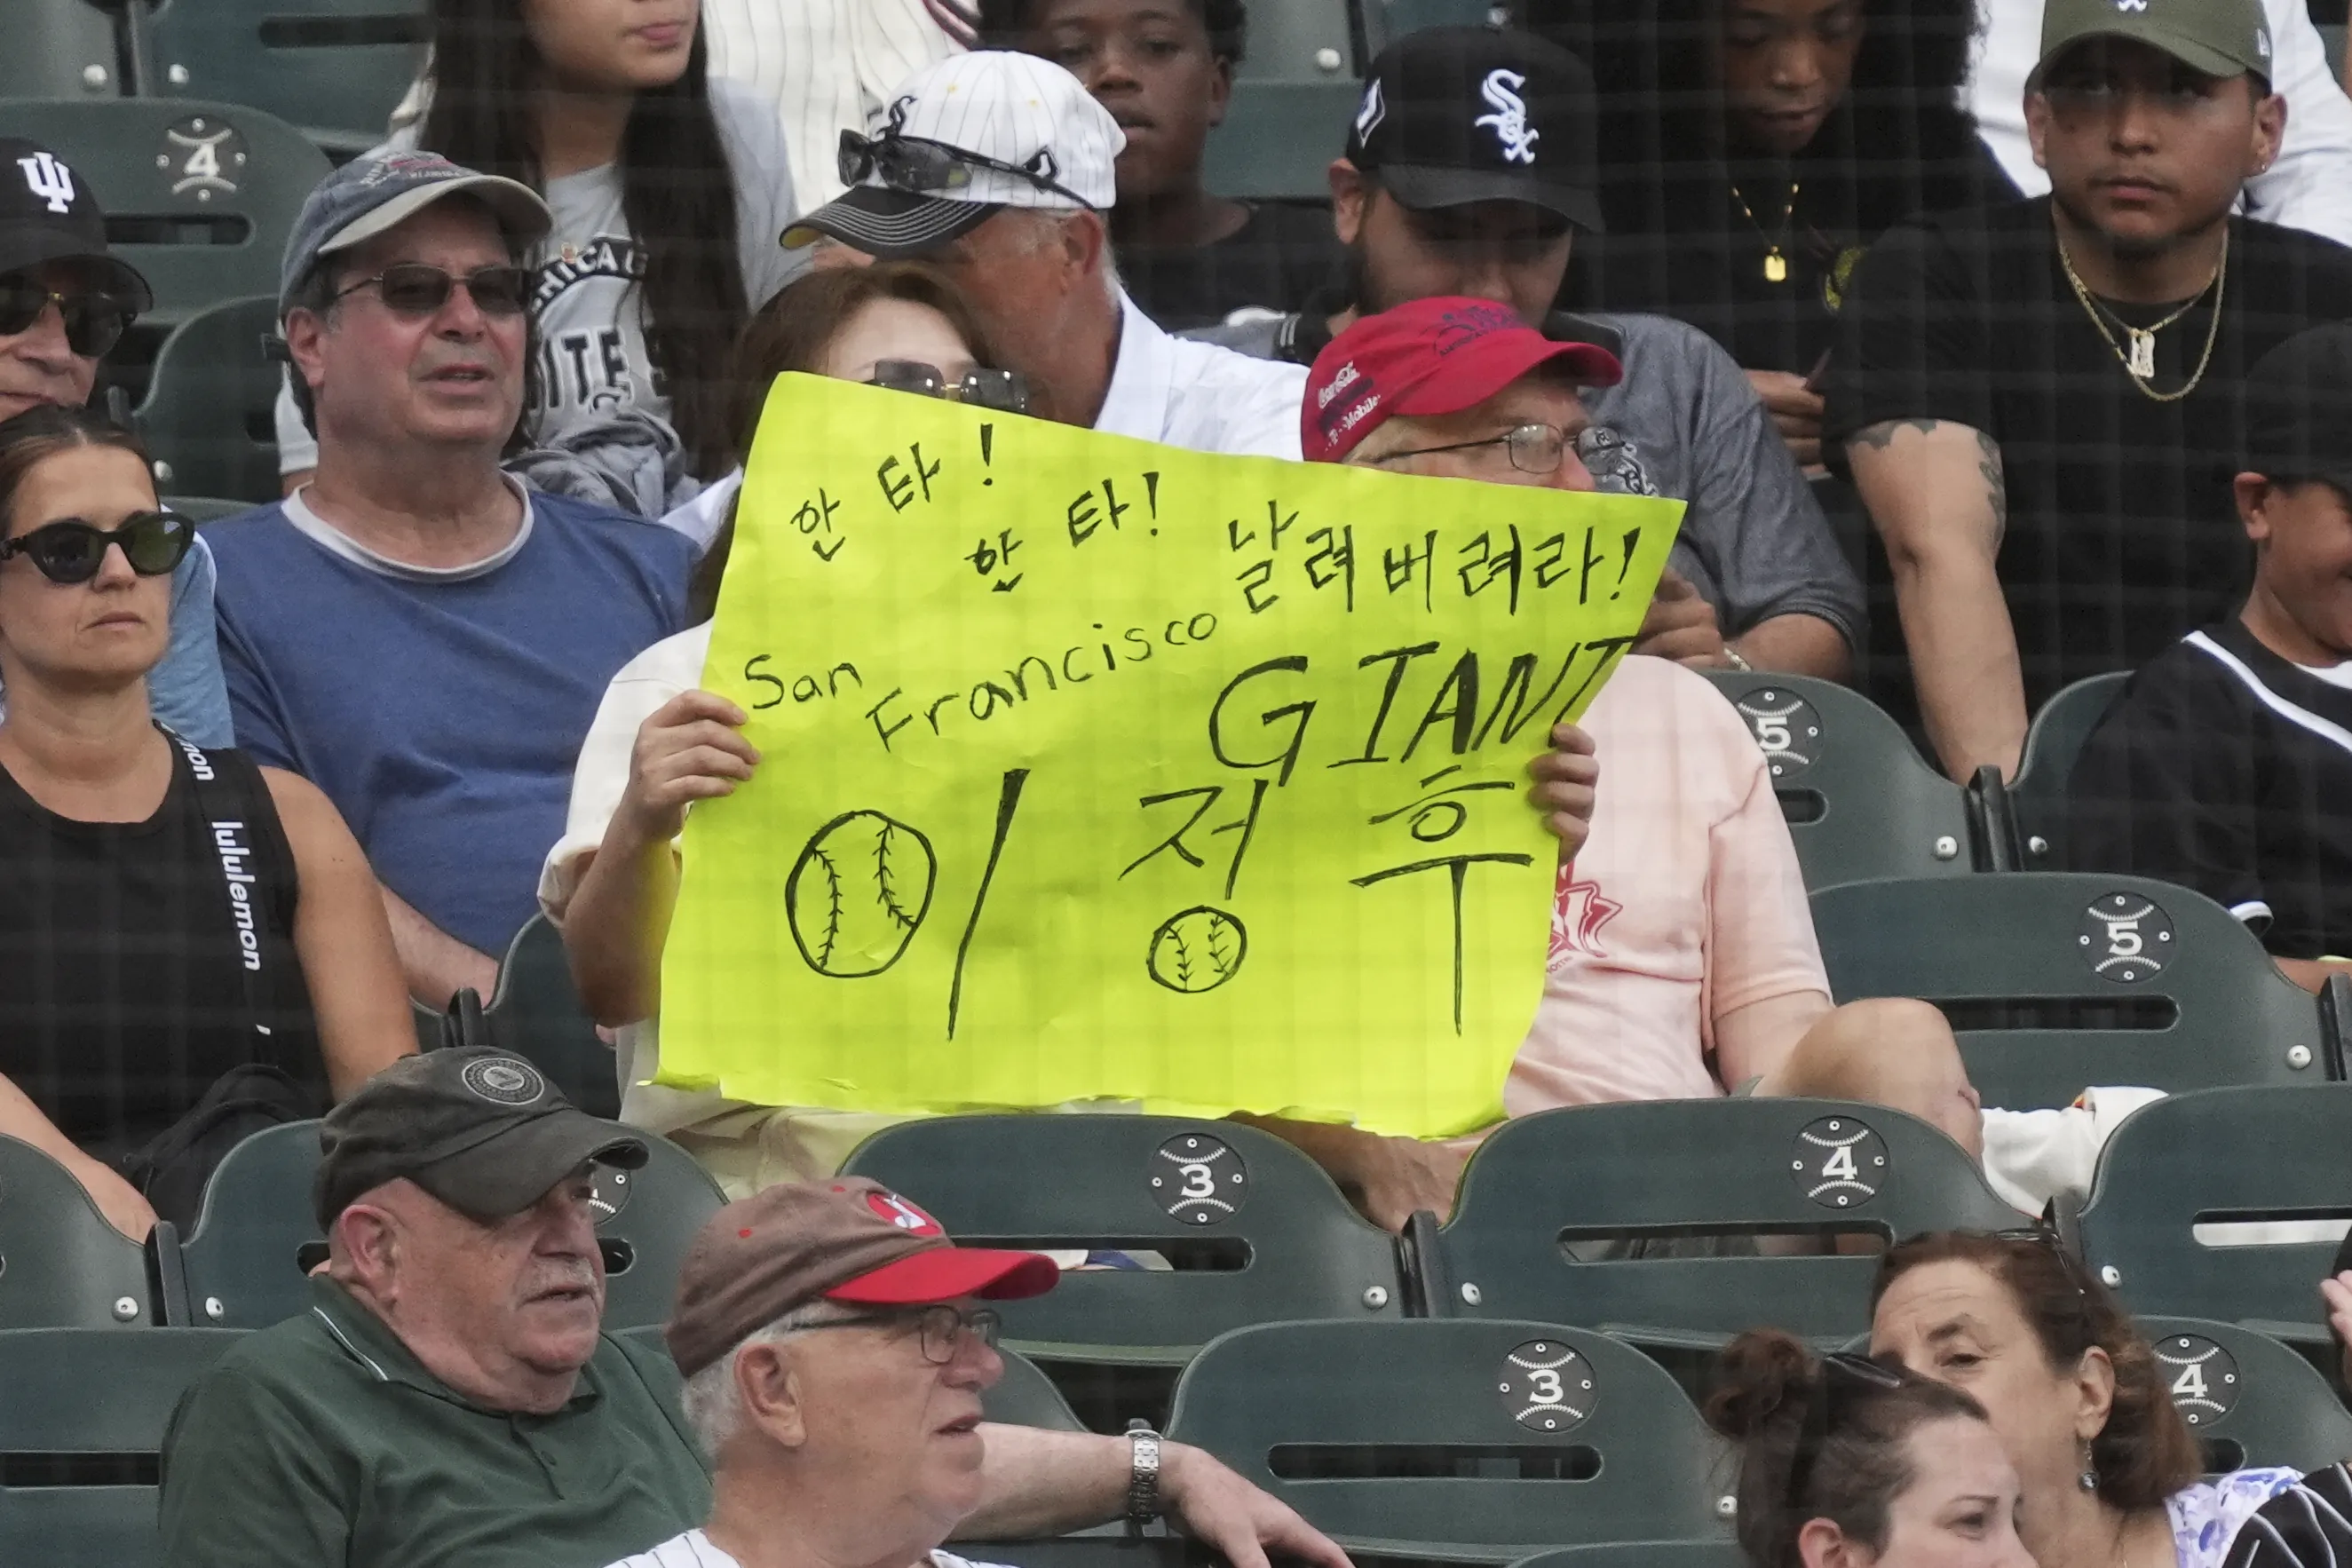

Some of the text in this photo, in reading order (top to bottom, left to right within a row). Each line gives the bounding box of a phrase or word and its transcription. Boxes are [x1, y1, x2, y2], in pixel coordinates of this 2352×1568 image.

[184, 142, 220, 178] 4
[744, 613, 1216, 753] San Francisco
[1757, 717, 1792, 751] 5
[211, 821, 261, 970] lululemon
[2107, 921, 2142, 956] 5
[1178, 1163, 1216, 1199] 3
[1822, 1145, 1858, 1181] 4
[1527, 1369, 1564, 1404] 3
[2173, 1364, 2208, 1398] 4
